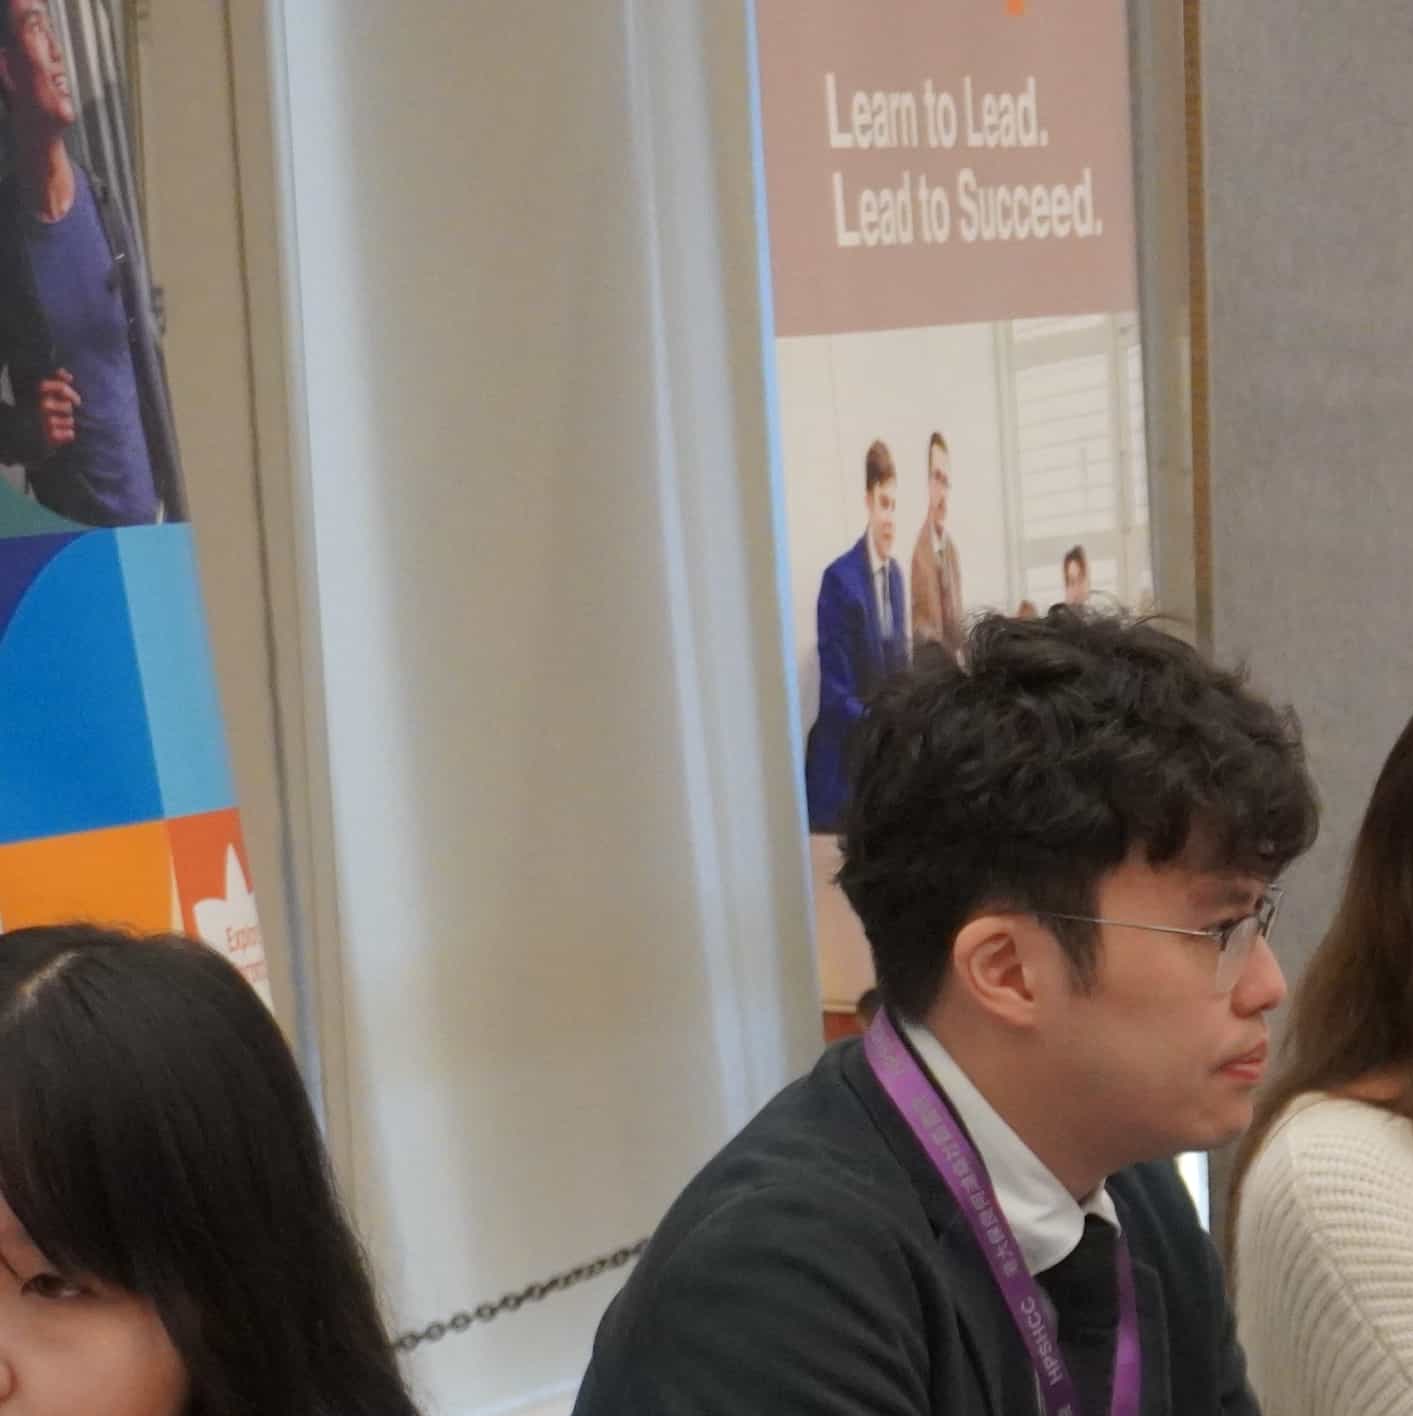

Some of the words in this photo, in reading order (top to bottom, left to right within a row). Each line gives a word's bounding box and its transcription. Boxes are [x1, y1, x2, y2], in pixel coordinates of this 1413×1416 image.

[825, 73, 919, 150] Learn
[925, 82, 959, 148] to
[964, 76, 1049, 148] Lead.
[834, 173, 913, 248] Lead
[918, 178, 952, 243] to
[959, 169, 1103, 240] Succeed.
